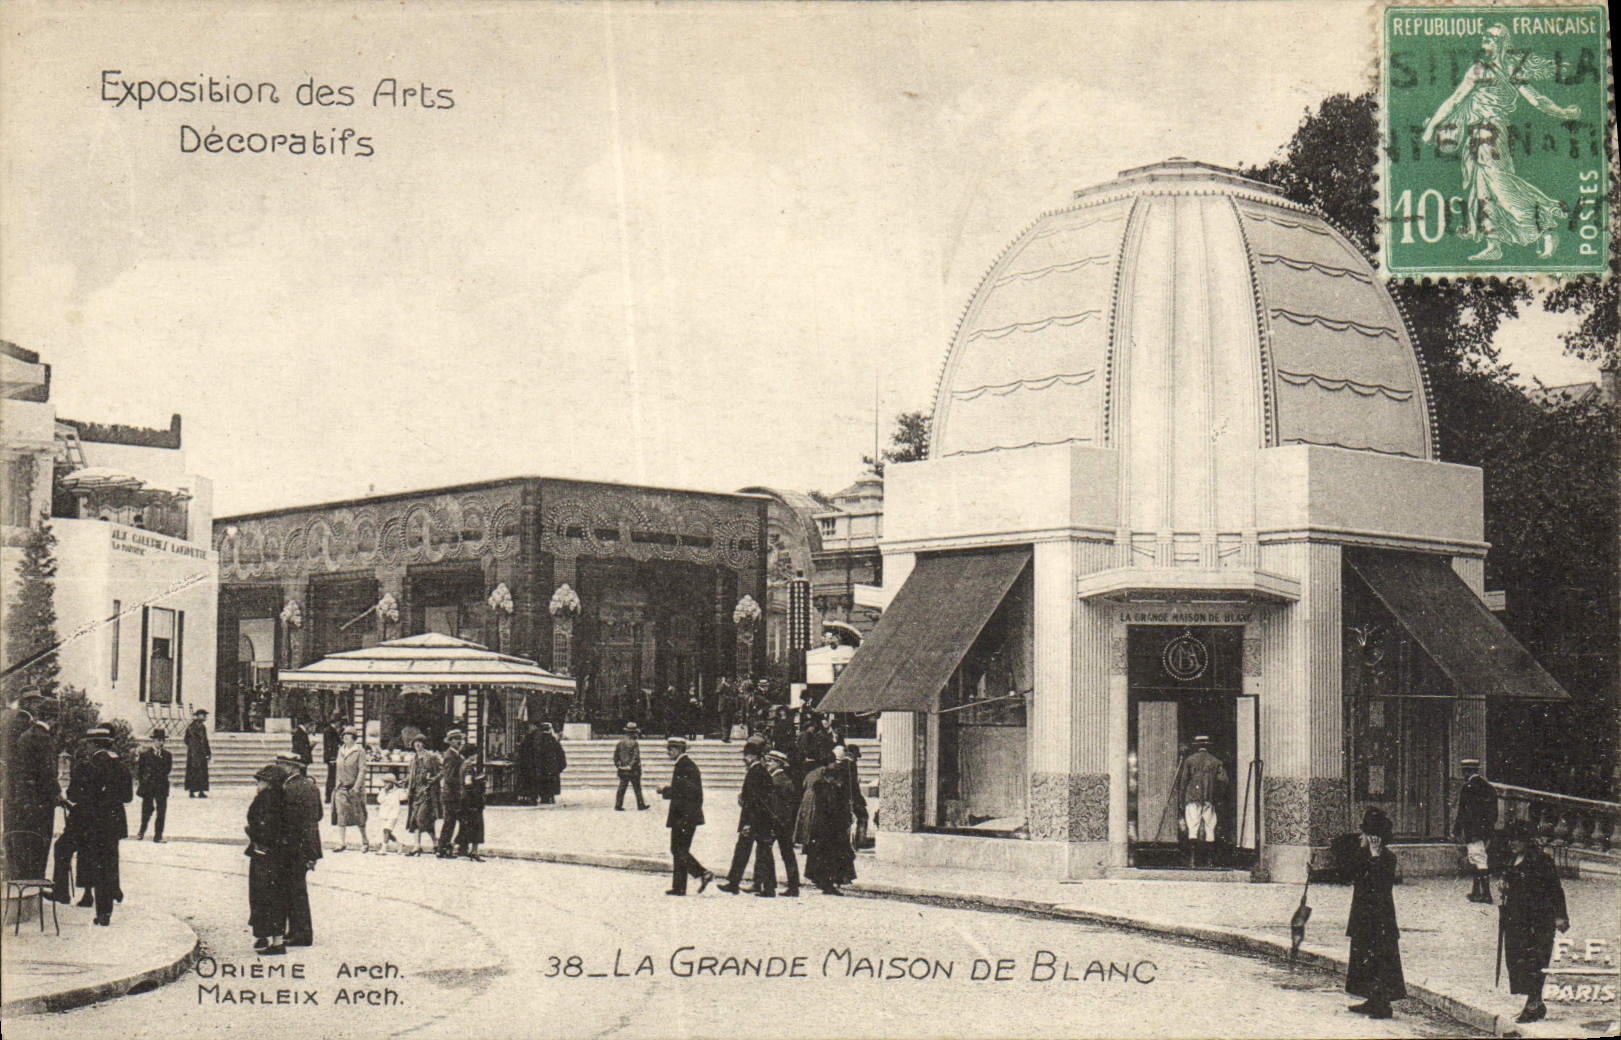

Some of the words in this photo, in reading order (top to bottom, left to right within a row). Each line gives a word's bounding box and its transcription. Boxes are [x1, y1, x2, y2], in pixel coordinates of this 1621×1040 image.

[1512, 16, 1597, 37] FRANÇAISE
[1579, 169, 1599, 256] POSTES
[1120, 612, 1132, 622] LA
[1134, 612, 1169, 622] GRANDE
[1172, 612, 1206, 622] MAISON
[1209, 612, 1221, 622] DE
[1224, 612, 1252, 622] BLANC
